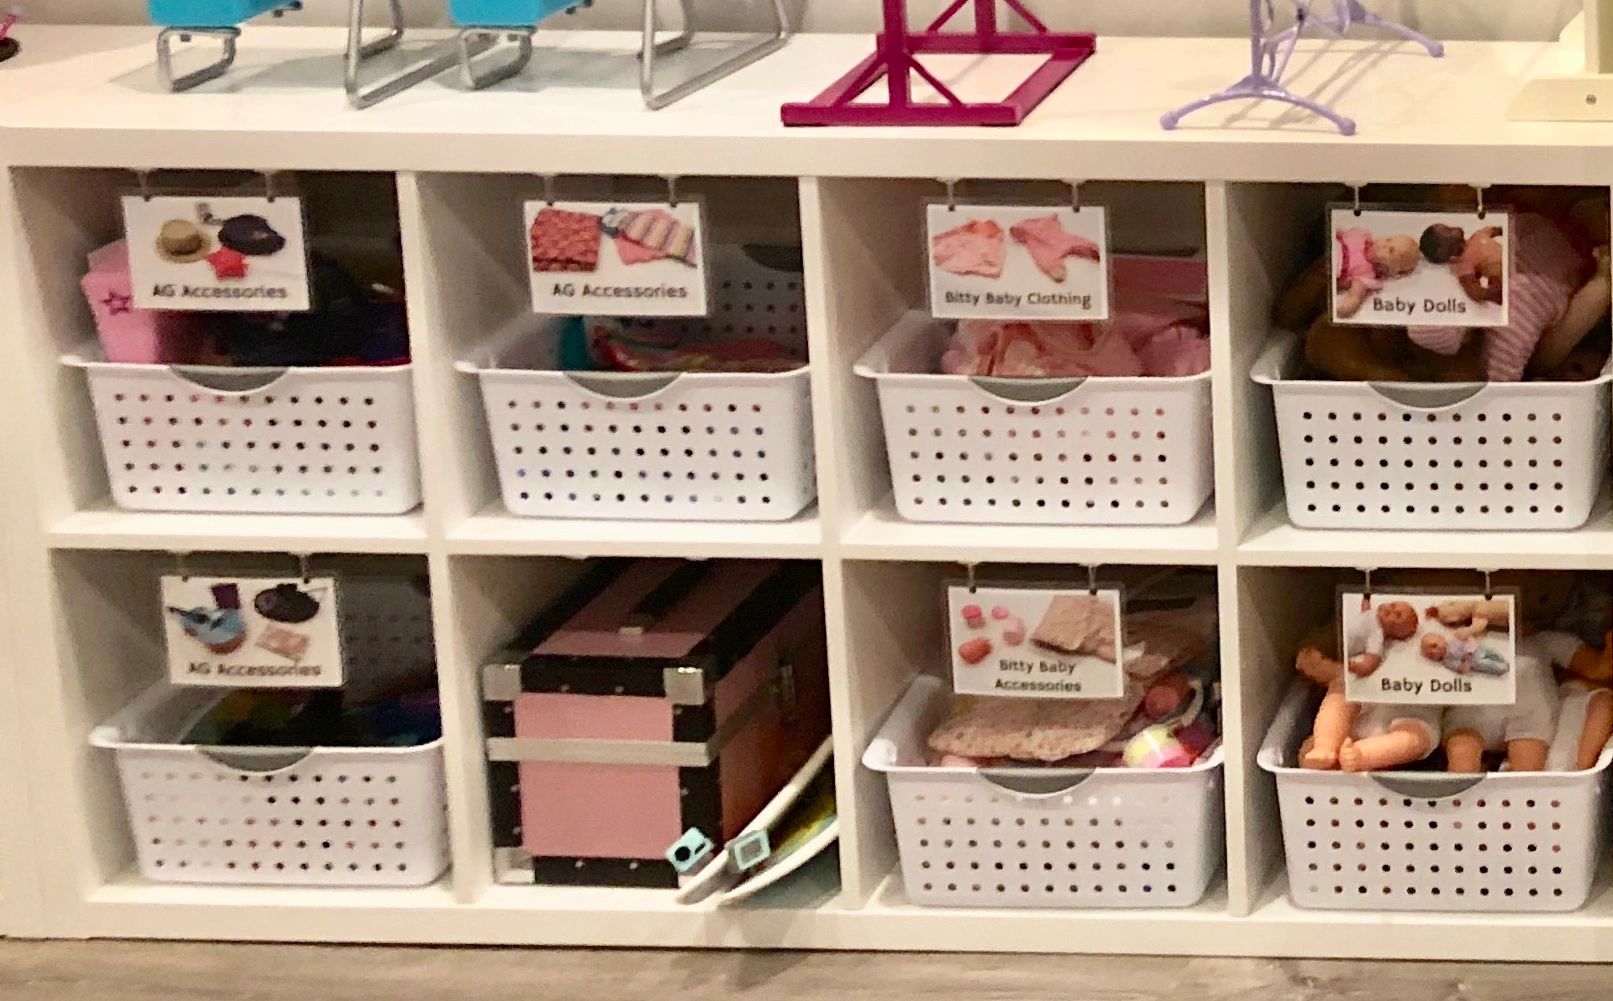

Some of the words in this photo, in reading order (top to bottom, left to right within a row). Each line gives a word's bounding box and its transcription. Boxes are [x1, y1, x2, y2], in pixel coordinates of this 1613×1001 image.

[153, 284, 175, 297] AG
[182, 284, 288, 299] Accessories
[553, 284, 575, 297] AG
[583, 283, 687, 299] Accessories
[945, 291, 979, 306] Bitty
[986, 291, 1022, 307] Baby
[1027, 292, 1091, 310] Clothing
[1373, 297, 1415, 314] Baby
[1424, 298, 1466, 313] Dolls
[999, 660, 1033, 674] Bitty
[1039, 660, 1076, 675] Baby
[995, 679, 1082, 692] Accessories
[1381, 678, 1423, 695] Baby
[1430, 678, 1472, 693] Dolls
